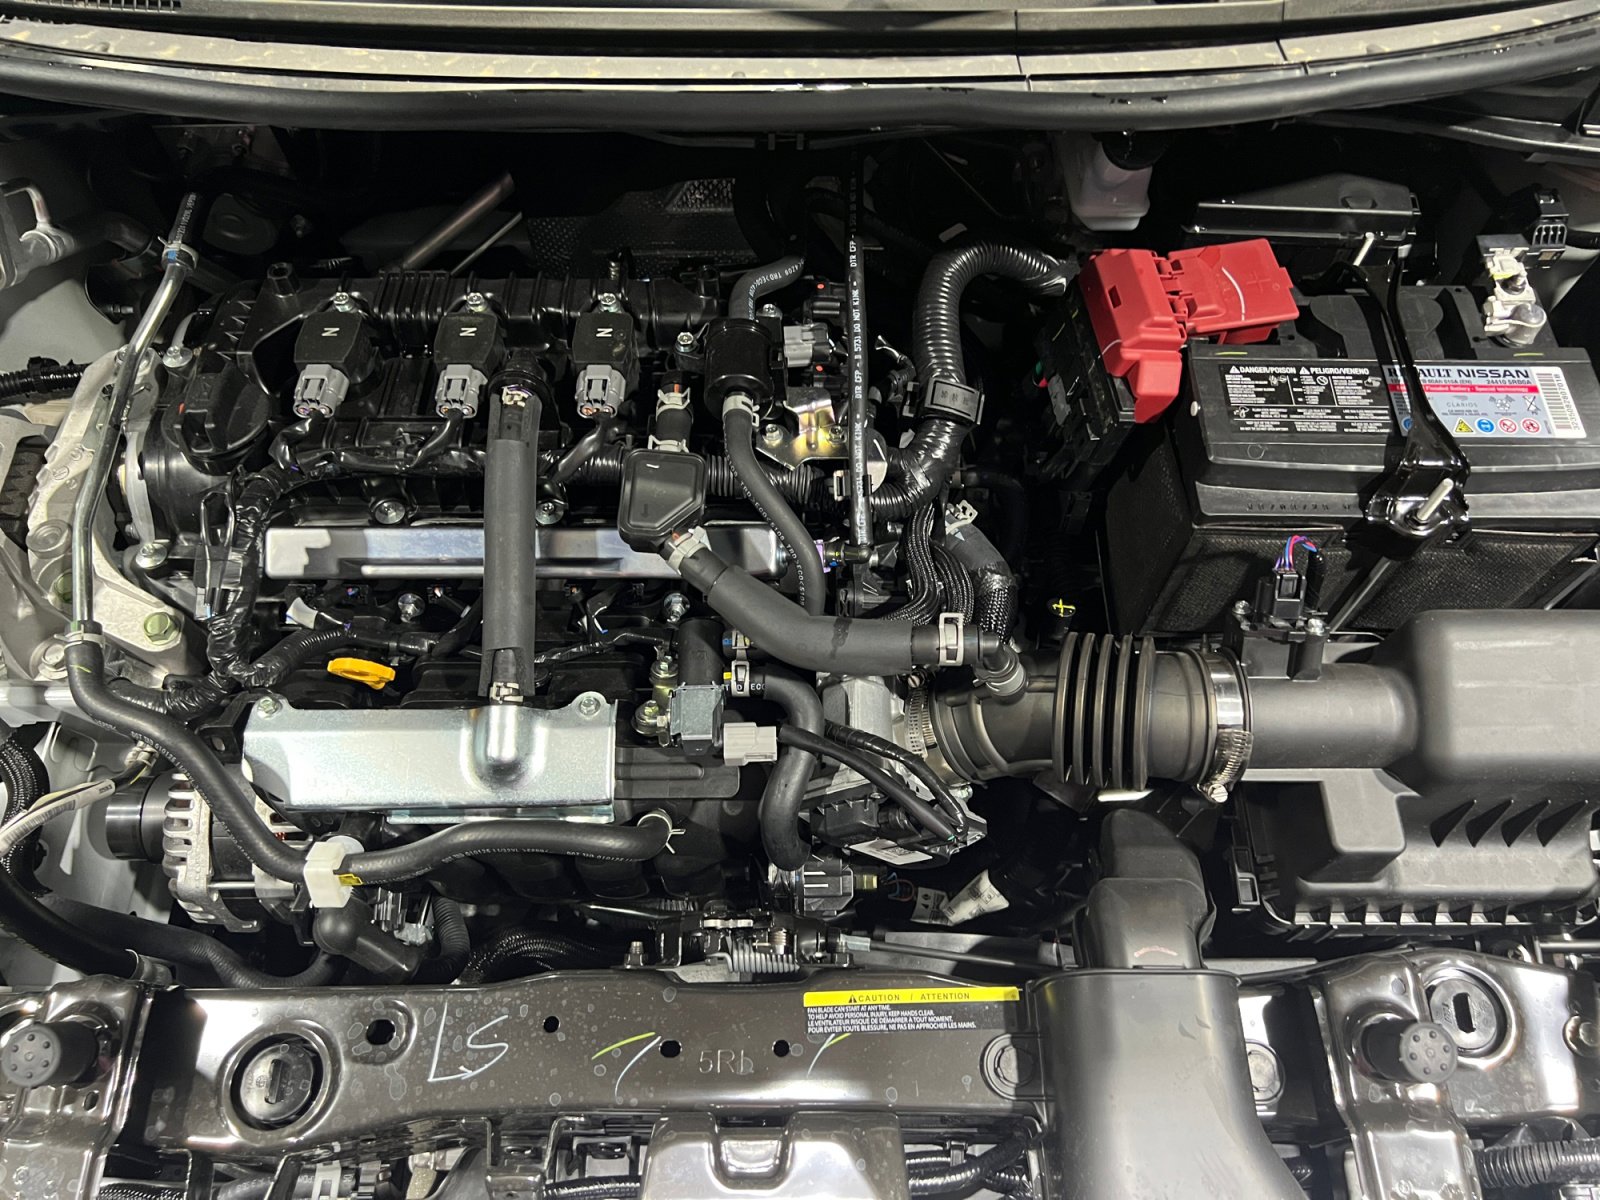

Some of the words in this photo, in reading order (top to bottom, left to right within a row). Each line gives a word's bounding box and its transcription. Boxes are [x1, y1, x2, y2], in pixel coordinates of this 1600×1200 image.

[852, 289, 860, 306] KINK
[853, 308, 861, 321] NOT
[853, 323, 861, 333] DO
[854, 335, 862, 352] 5731
[1239, 366, 1297, 375] DANGER/POISON
[1309, 367, 1370, 375] PELIGRO/VENENO
[1388, 368, 1452, 378] RAULT
[1457, 369, 1530, 379] NISSAN
[858, 994, 900, 1002] CAUTION
[920, 992, 970, 1001] ATTENTION
[815, 1019, 850, 1027] VENTILATEUR
[916, 1022, 947, 1030] APPROCHER
